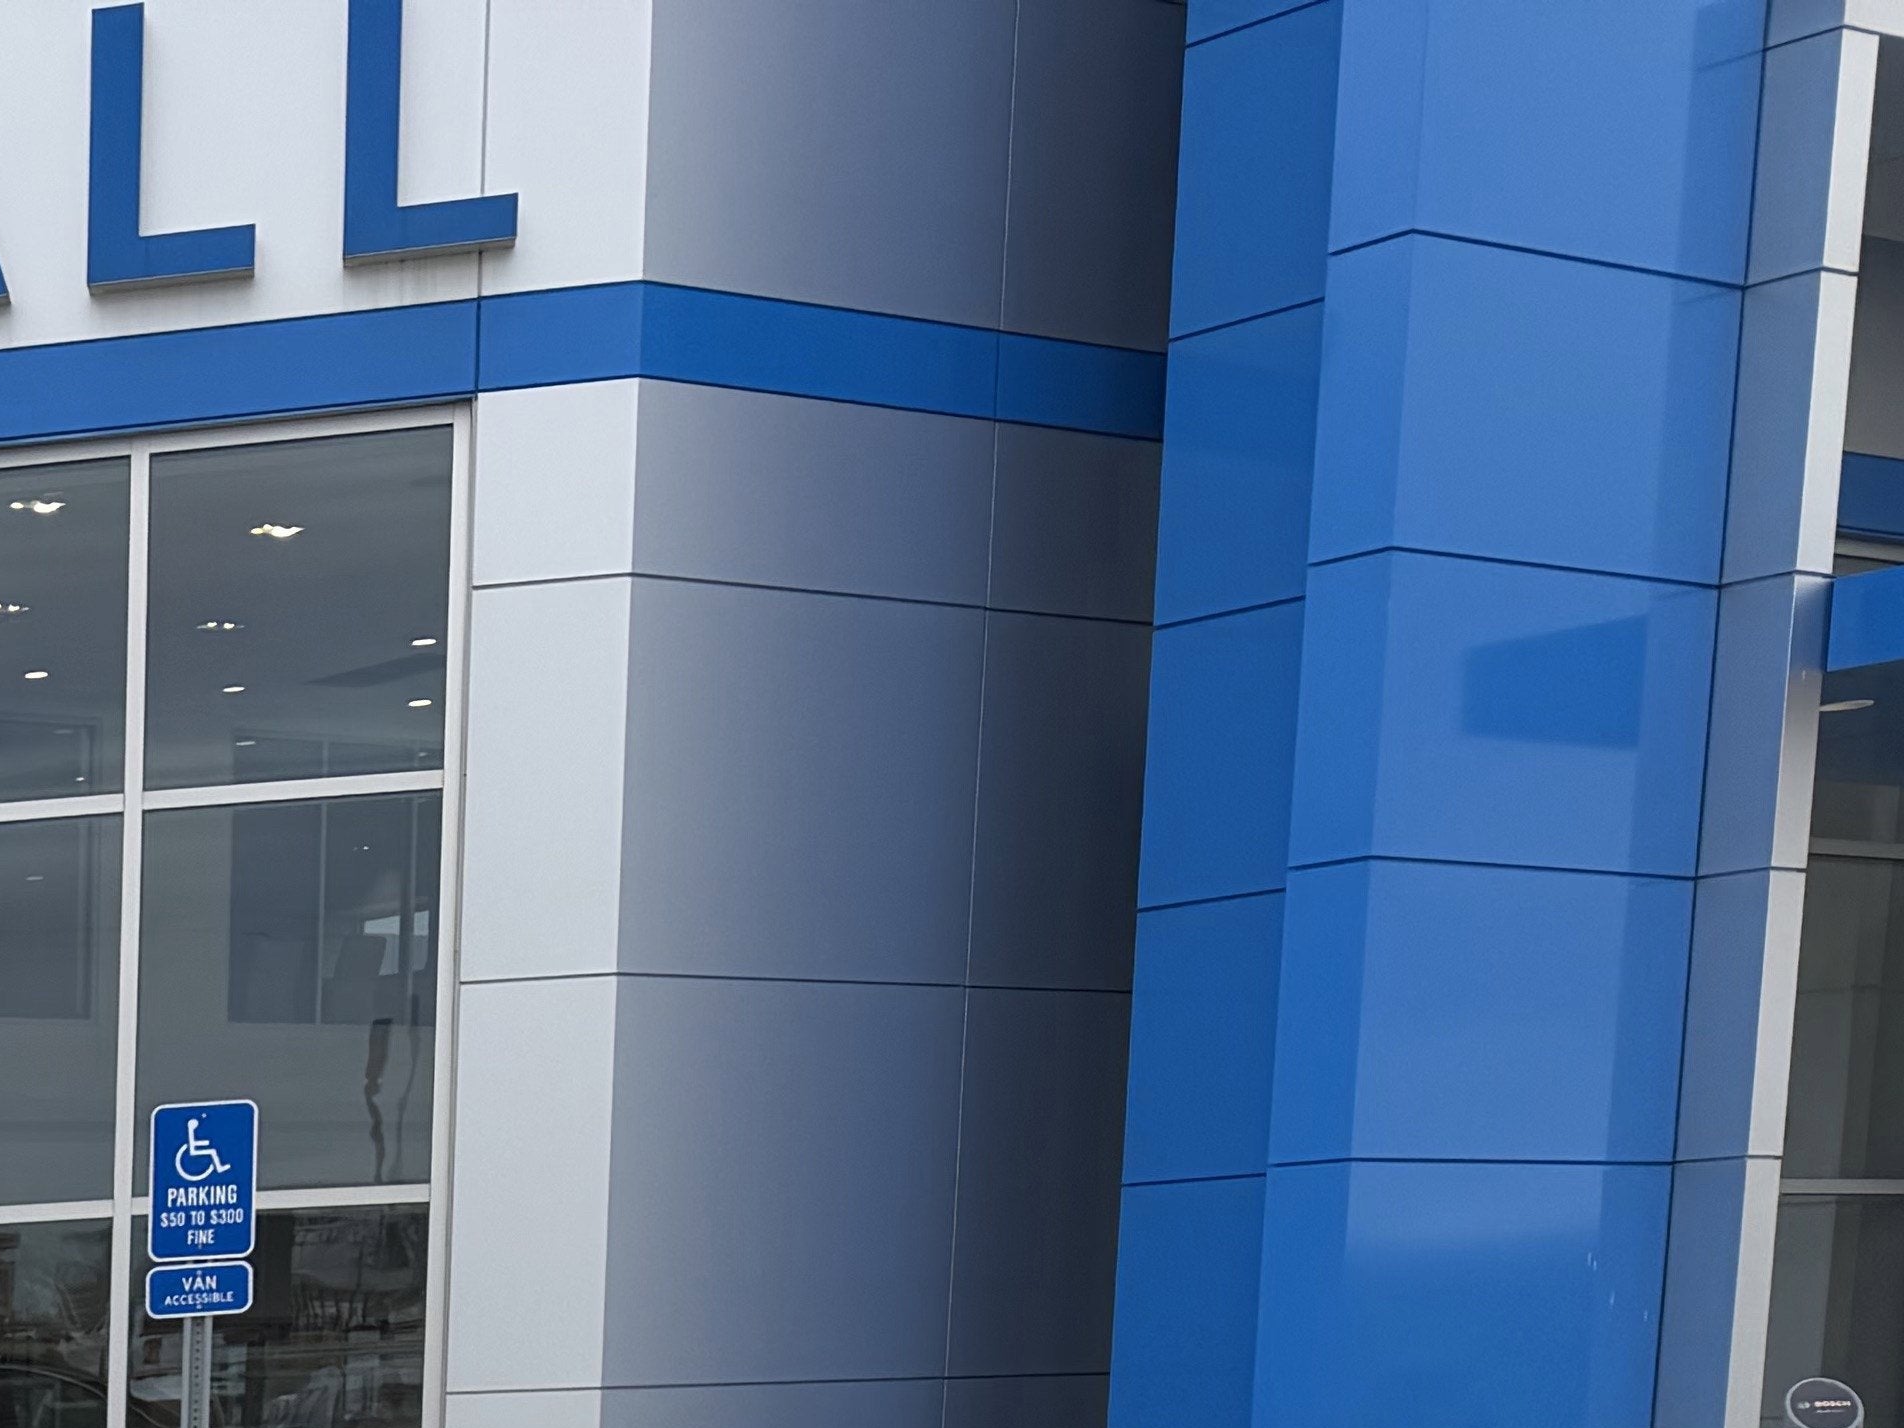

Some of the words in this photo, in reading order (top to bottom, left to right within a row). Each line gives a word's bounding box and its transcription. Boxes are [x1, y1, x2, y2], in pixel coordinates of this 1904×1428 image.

[167, 1184, 238, 1208] PARKING
[160, 1211, 186, 1228] $50
[191, 1210, 205, 1226] TO
[210, 1208, 244, 1224] $300
[187, 1229, 215, 1245] FINE
[182, 1275, 217, 1292] VAN
[164, 1291, 234, 1306] ACCESSIBLE
